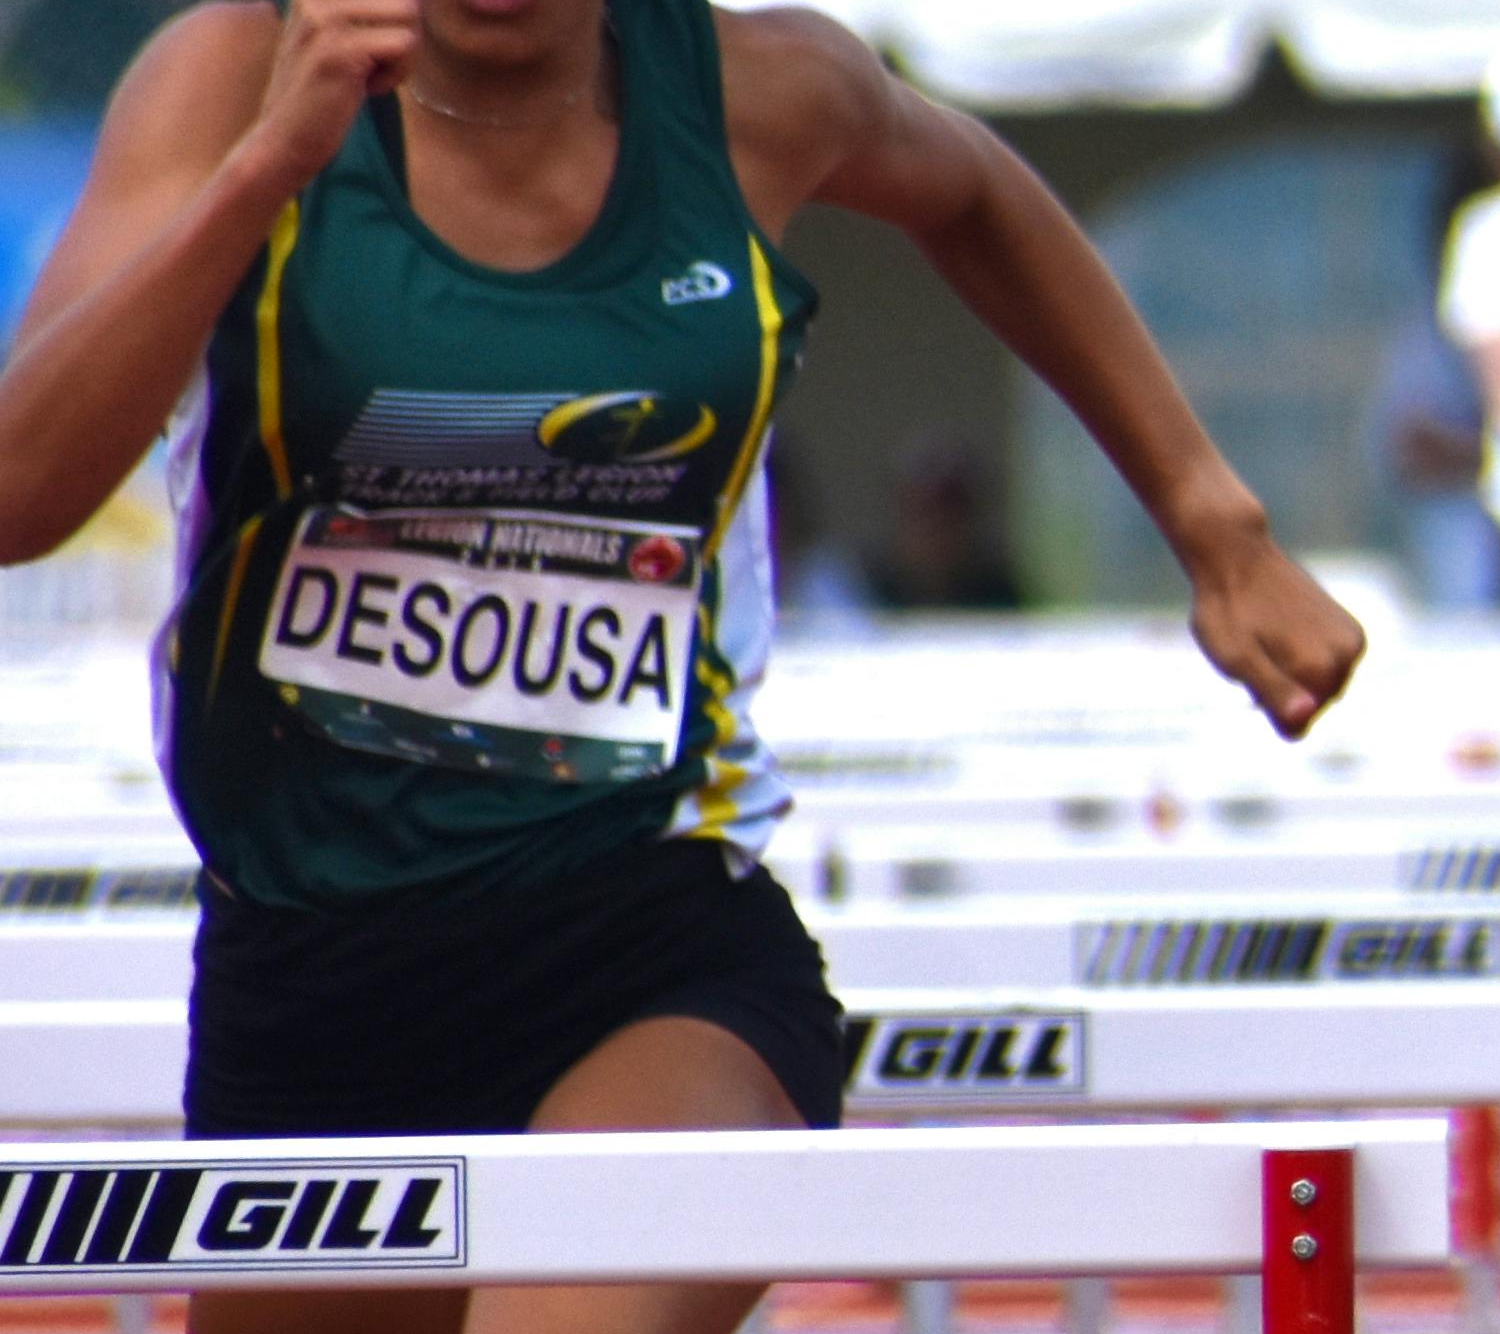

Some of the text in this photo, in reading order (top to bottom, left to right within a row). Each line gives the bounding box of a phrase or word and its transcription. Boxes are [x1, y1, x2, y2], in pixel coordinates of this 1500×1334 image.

[399, 519, 488, 553] LEGION
[491, 520, 625, 565] NATIONALS
[275, 565, 672, 712] DESOUSA
[1337, 926, 1490, 970] GILL
[878, 1025, 1070, 1079] GILL
[197, 1177, 443, 1252] GILL
